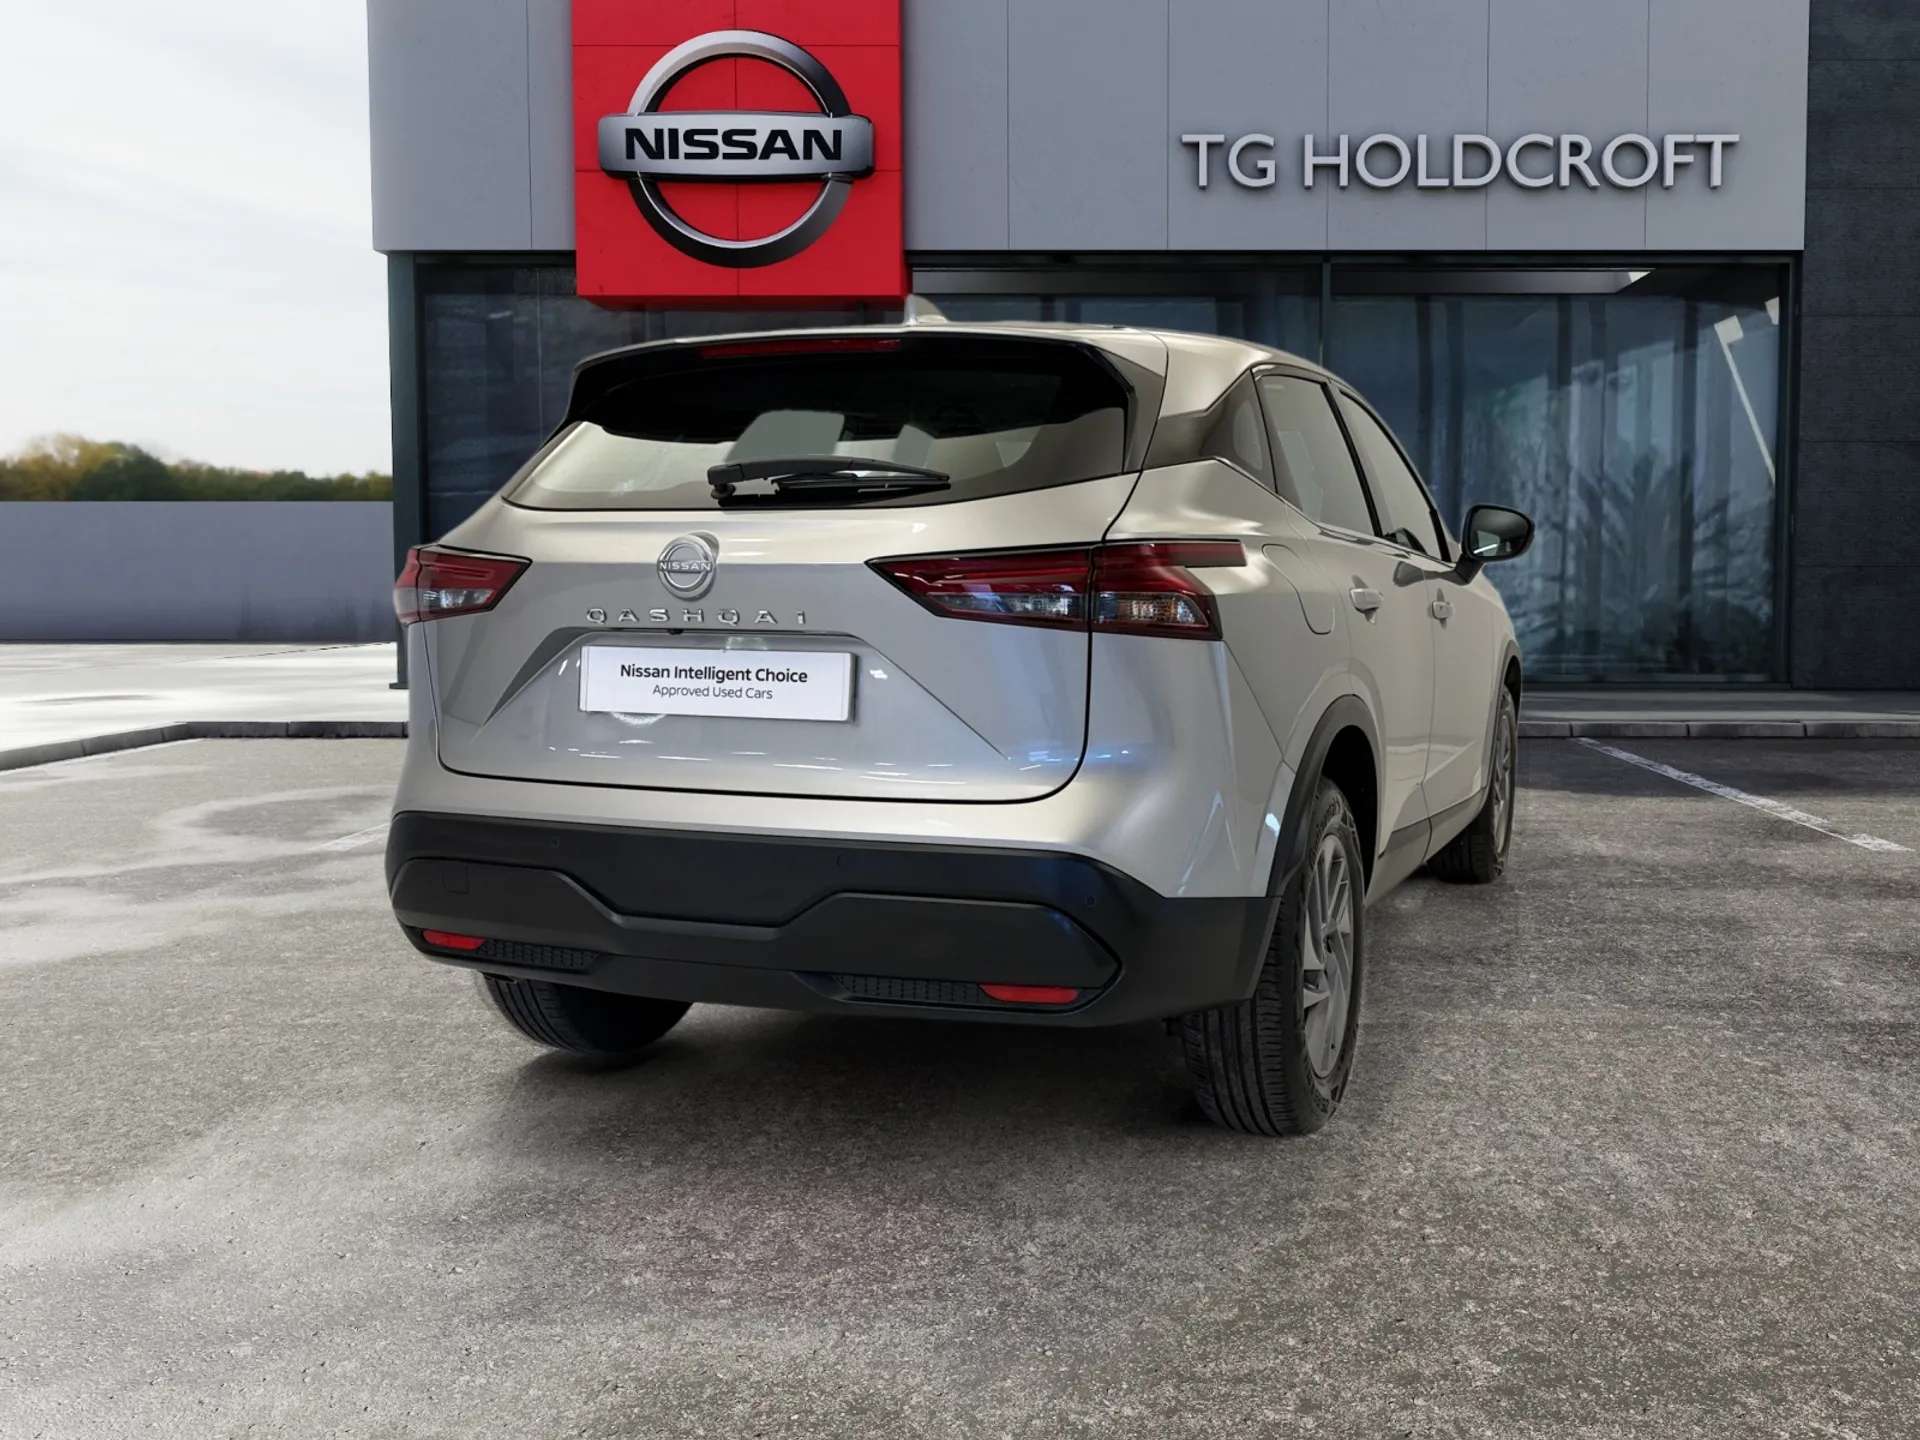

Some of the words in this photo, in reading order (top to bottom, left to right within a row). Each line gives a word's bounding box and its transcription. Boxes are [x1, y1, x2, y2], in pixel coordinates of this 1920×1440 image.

[625, 128, 842, 160] NISSAN
[1182, 133, 1276, 188] TG
[1303, 133, 1740, 189] HOLDCROFT
[659, 561, 711, 571] NISSAN
[620, 664, 670, 678] Nissan
[674, 666, 752, 683] Intelligent
[755, 668, 808, 682] Choice
[652, 685, 710, 698] Approved
[712, 687, 743, 698] Used
[745, 688, 773, 699] Cars
